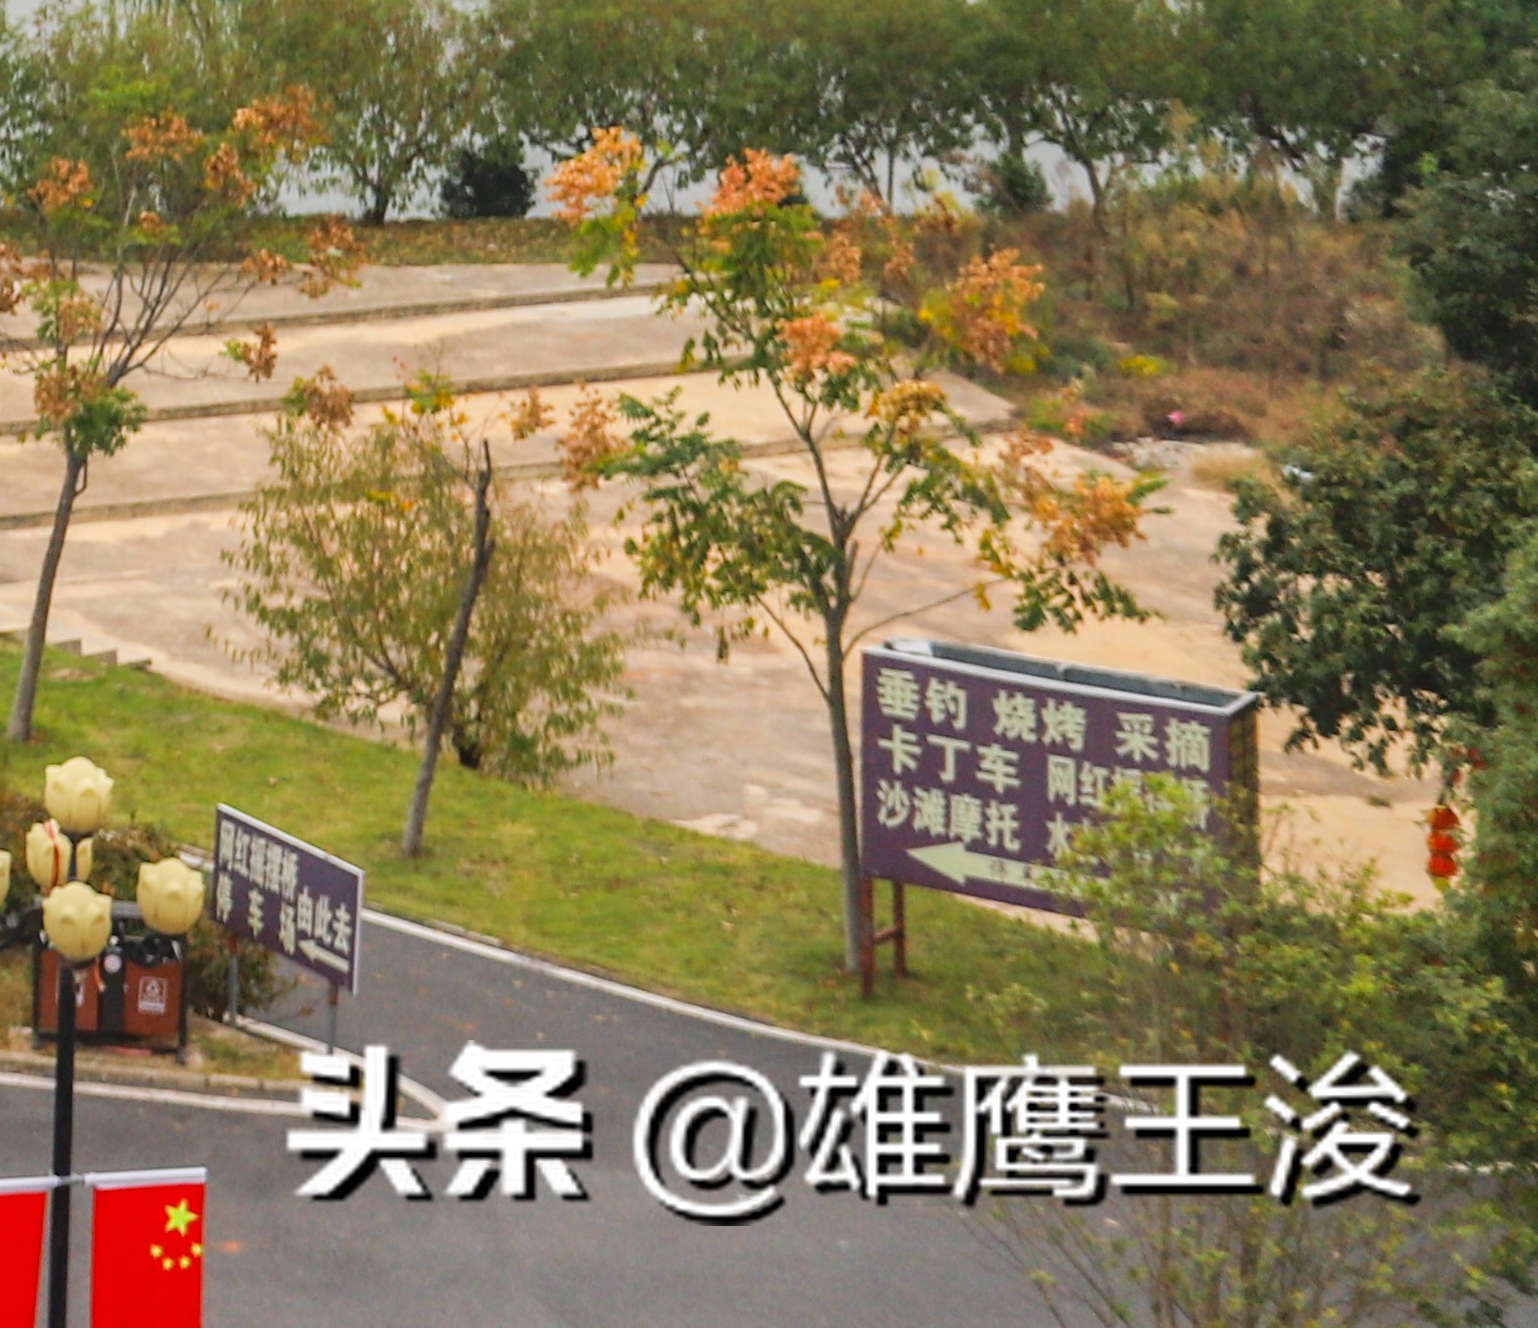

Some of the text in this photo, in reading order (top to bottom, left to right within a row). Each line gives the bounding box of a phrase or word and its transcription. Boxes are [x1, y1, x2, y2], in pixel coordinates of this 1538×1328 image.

[876, 667, 1212, 773] 垂钓 烧烤 采摘
[877, 723, 1022, 794] 卡丁车
[876, 778, 1022, 853] 沙滩摩托
[296, 884, 353, 956] 由此去
